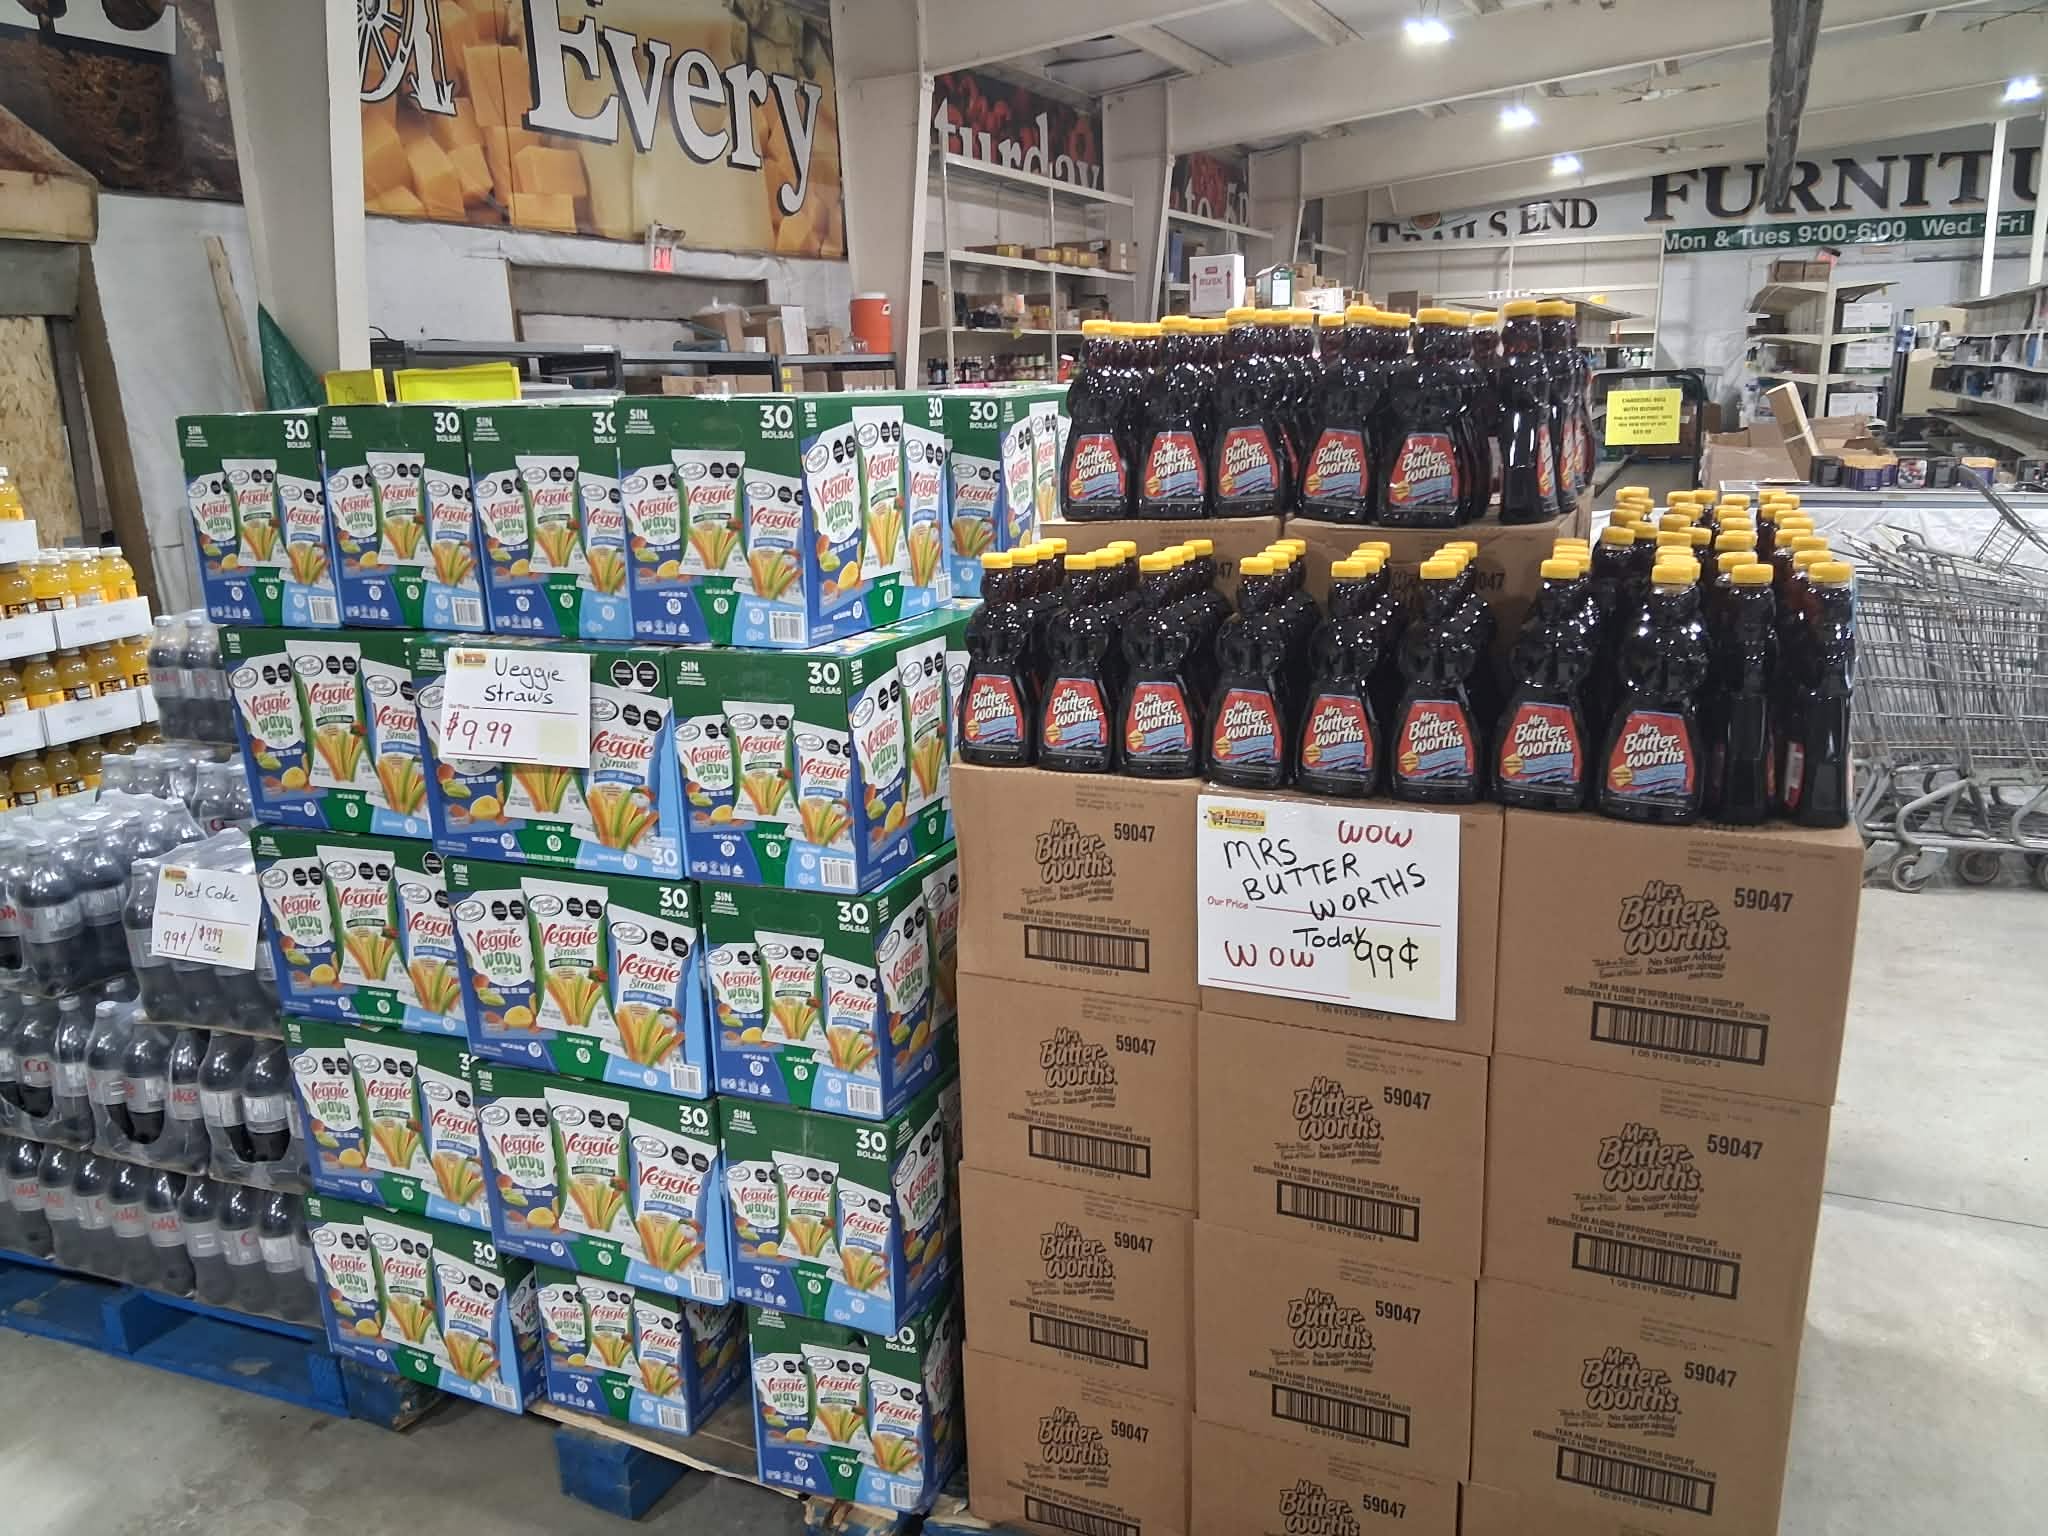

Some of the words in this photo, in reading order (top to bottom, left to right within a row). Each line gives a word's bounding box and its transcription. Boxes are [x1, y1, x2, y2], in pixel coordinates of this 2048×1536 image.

[522, 0, 822, 217] Every
[1519, 198, 1598, 235] END
[1665, 231, 1706, 251] Mon
[1714, 230, 1730, 247] &
[1738, 227, 1790, 246] Tues
[1799, 219, 1906, 243] 9:00-6:00
[1922, 216, 1972, 237] Wed
[1995, 213, 2026, 233] Fri
[629, 408, 648, 420] SIN
[759, 404, 793, 429] 30
[928, 397, 943, 419] 30
[968, 401, 998, 421] 30
[283, 418, 310, 441] 30
[433, 411, 460, 435] 30
[761, 430, 795, 440] BOLSAS
[968, 421, 998, 430] BOLSAS
[680, 660, 699, 672] SIN
[807, 661, 841, 685] 30
[484, 682, 555, 705] Straws
[809, 685, 842, 695] BOLSAS
[445, 711, 513, 751] $9.99
[1113, 822, 1156, 843] 59047
[1337, 819, 1413, 848] WOW
[651, 847, 678, 867] 30
[1223, 837, 1297, 870] MRS
[1241, 852, 1361, 901] BUTTER
[174, 881, 202, 899] Diet
[205, 885, 239, 902] Coke
[658, 886, 689, 909] 30
[714, 890, 732, 902] SIN
[1207, 895, 1225, 906] Our
[1225, 898, 1249, 910] Price
[1309, 862, 1426, 921] WORTHS
[1734, 887, 1794, 913] 59047
[660, 908, 690, 919] BOLSAS
[836, 900, 870, 924] 30
[538, 922, 599, 948] Veggie
[838, 923, 871, 934] BOLSAS
[1292, 925, 1367, 949] Today
[617, 949, 681, 984] Veggie
[1353, 936, 1420, 980] 99¢
[1115, 1034, 1156, 1056] 59047
[1383, 1086, 1432, 1111] 59047
[678, 1104, 709, 1128] 30
[855, 1128, 888, 1152] 30
[1707, 1133, 1763, 1160] 59047
[856, 1150, 888, 1163] BOLSAS
[471, 1240, 497, 1261] 30
[1113, 1231, 1153, 1254] 59047
[1375, 1299, 1422, 1325] 59047
[1684, 1361, 1738, 1389] 59047
[1111, 1418, 1150, 1443] 59047
[1362, 1493, 1407, 1520] 59047
